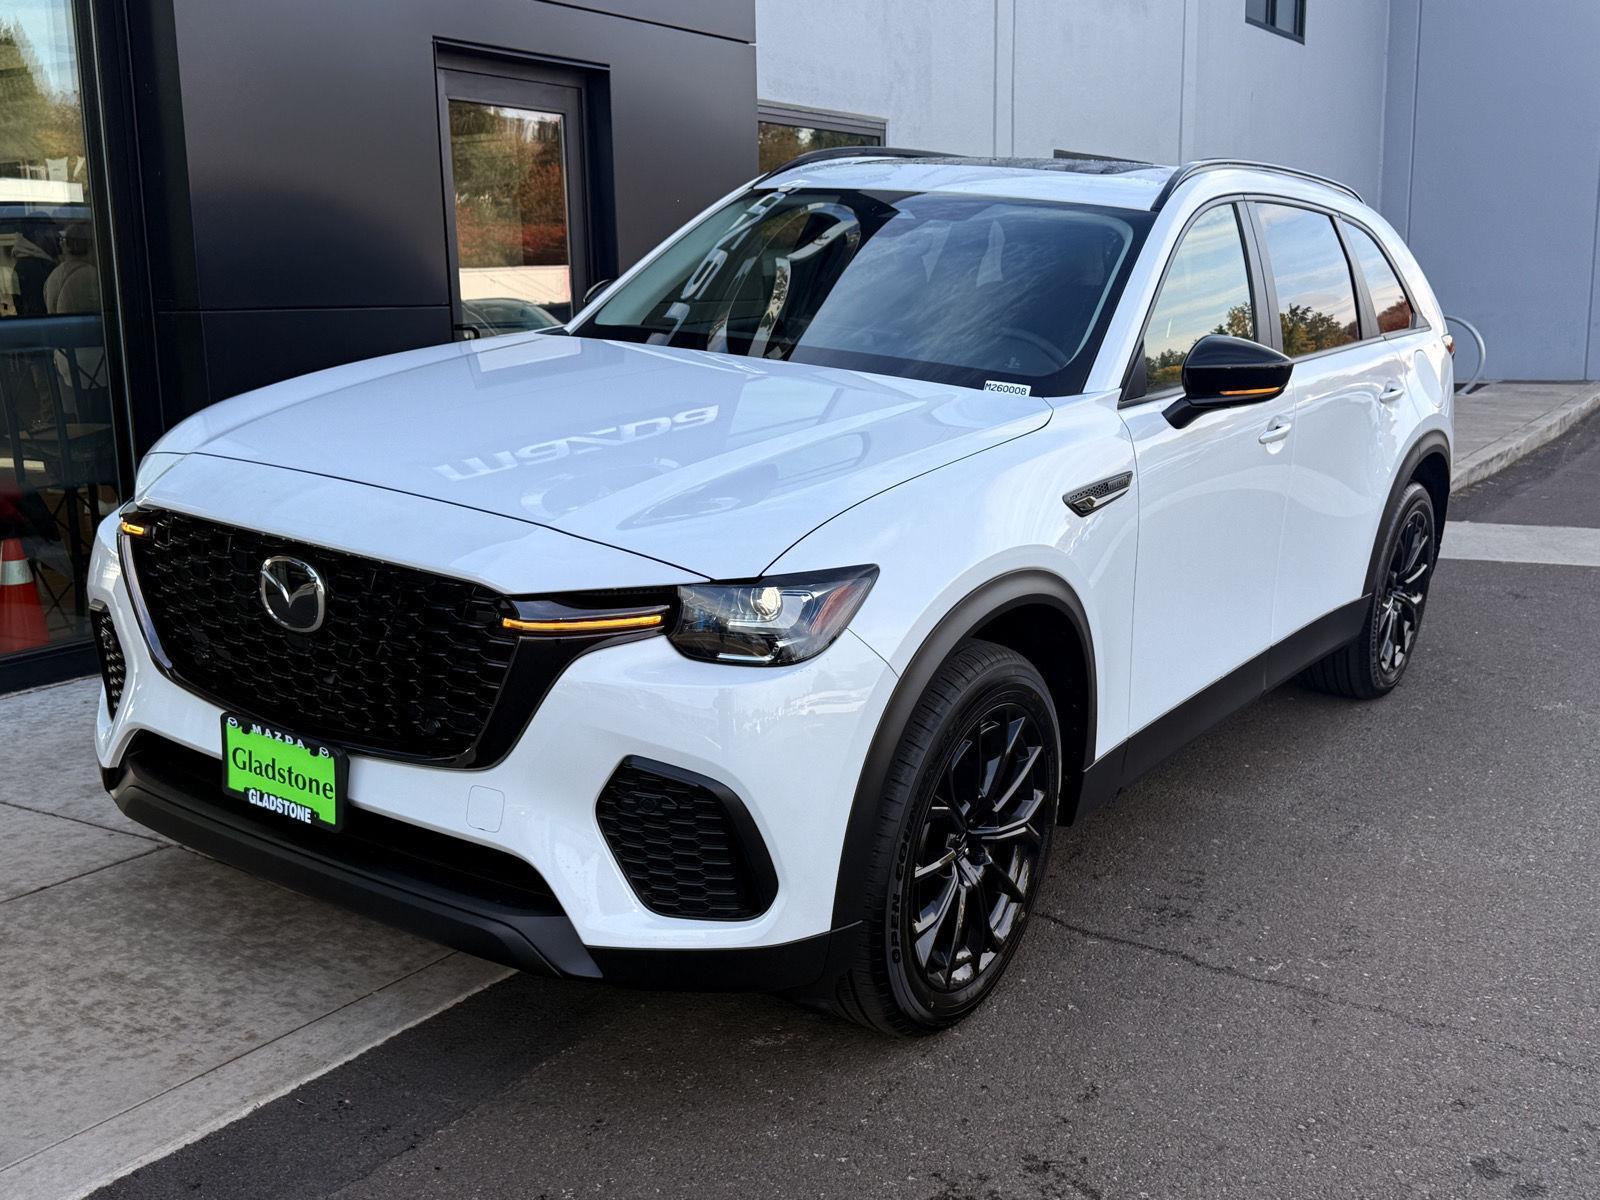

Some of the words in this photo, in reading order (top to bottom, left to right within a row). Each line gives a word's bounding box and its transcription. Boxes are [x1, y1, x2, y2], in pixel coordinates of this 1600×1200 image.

[984, 382, 1027, 396] M260008
[252, 723, 305, 749] MAZDA
[232, 746, 334, 800] Gladstone
[248, 788, 312, 824] GLADSTONE
[891, 892, 901, 964] OPEN
